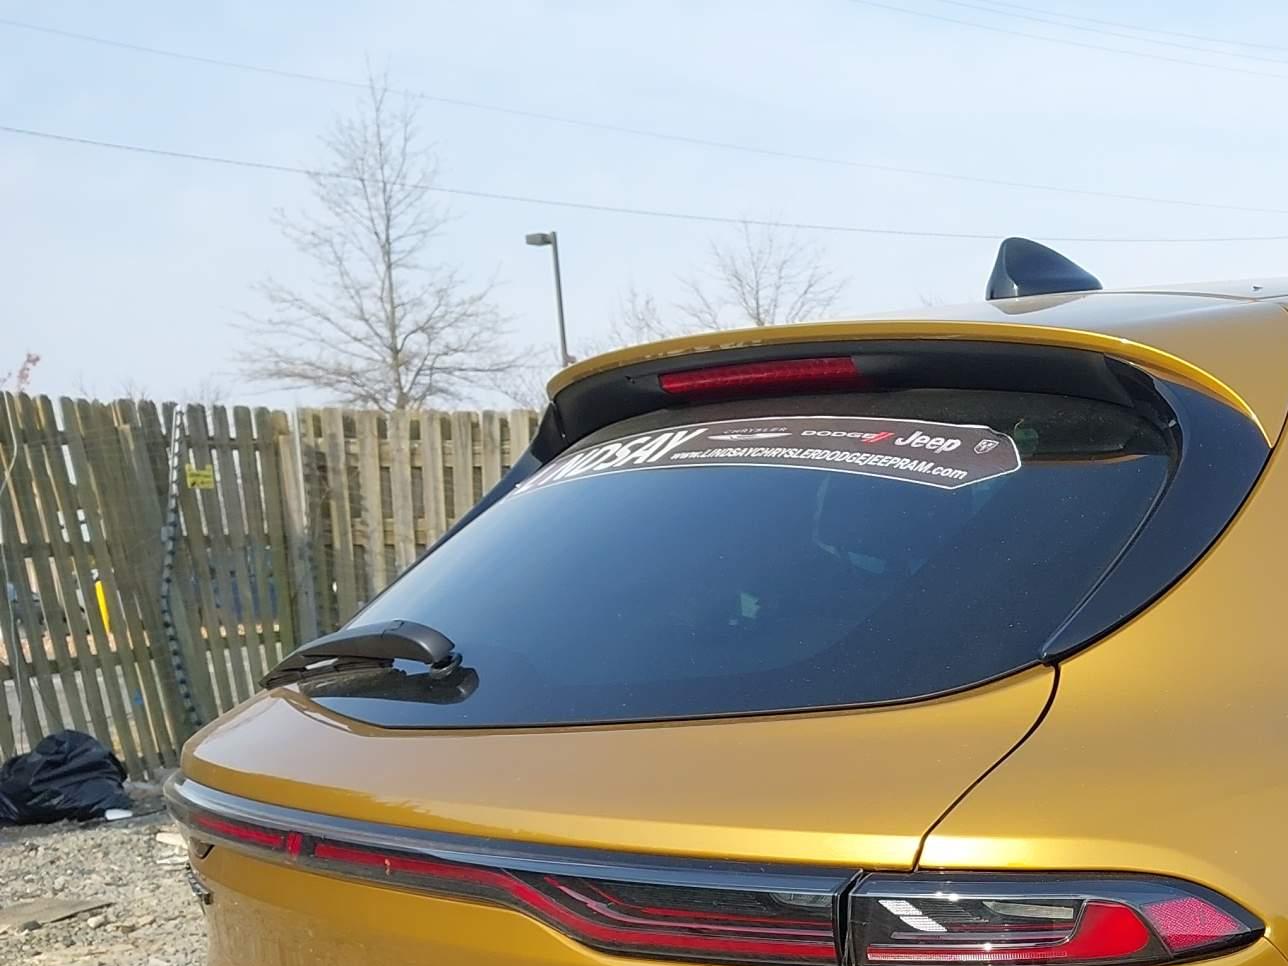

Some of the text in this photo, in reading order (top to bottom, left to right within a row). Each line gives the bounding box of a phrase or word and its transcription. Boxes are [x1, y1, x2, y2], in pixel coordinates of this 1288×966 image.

[723, 426, 962, 454] CHRYSLER DODGE Jeep
[670, 447, 968, 480] www.LINDSAYCHRYSLERDODGEJEEPRAM.com
